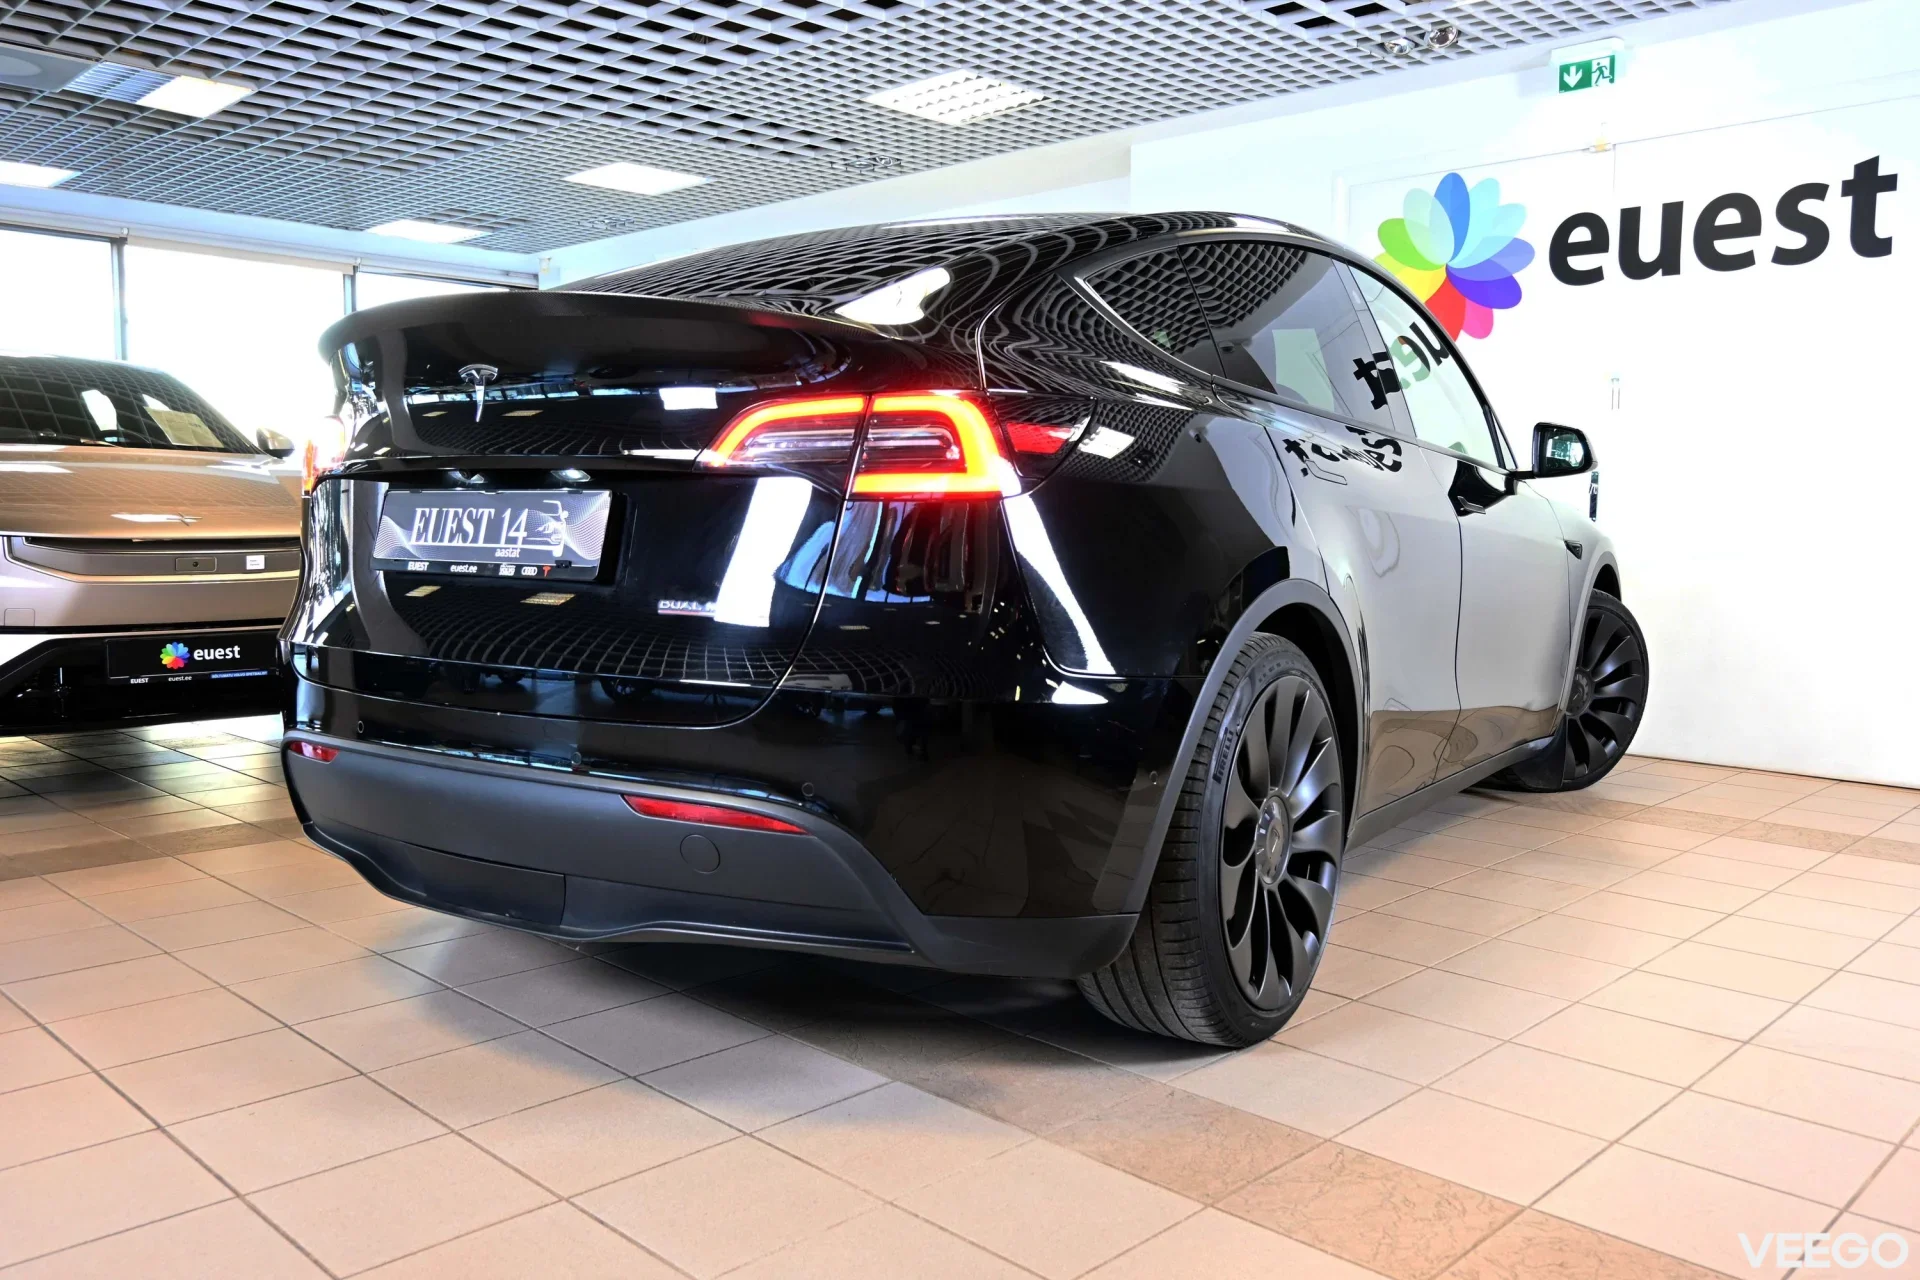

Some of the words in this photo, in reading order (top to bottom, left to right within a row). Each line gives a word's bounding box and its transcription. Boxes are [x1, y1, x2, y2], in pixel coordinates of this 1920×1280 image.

[1548, 154, 1898, 287] euest
[410, 507, 495, 545] EUEST
[501, 507, 529, 547] 14
[495, 547, 521, 558] aastat
[407, 561, 429, 571] EUEST
[450, 564, 477, 574] euest.ee
[193, 645, 241, 660] euest
[1212, 726, 1234, 785] PIRELLI
